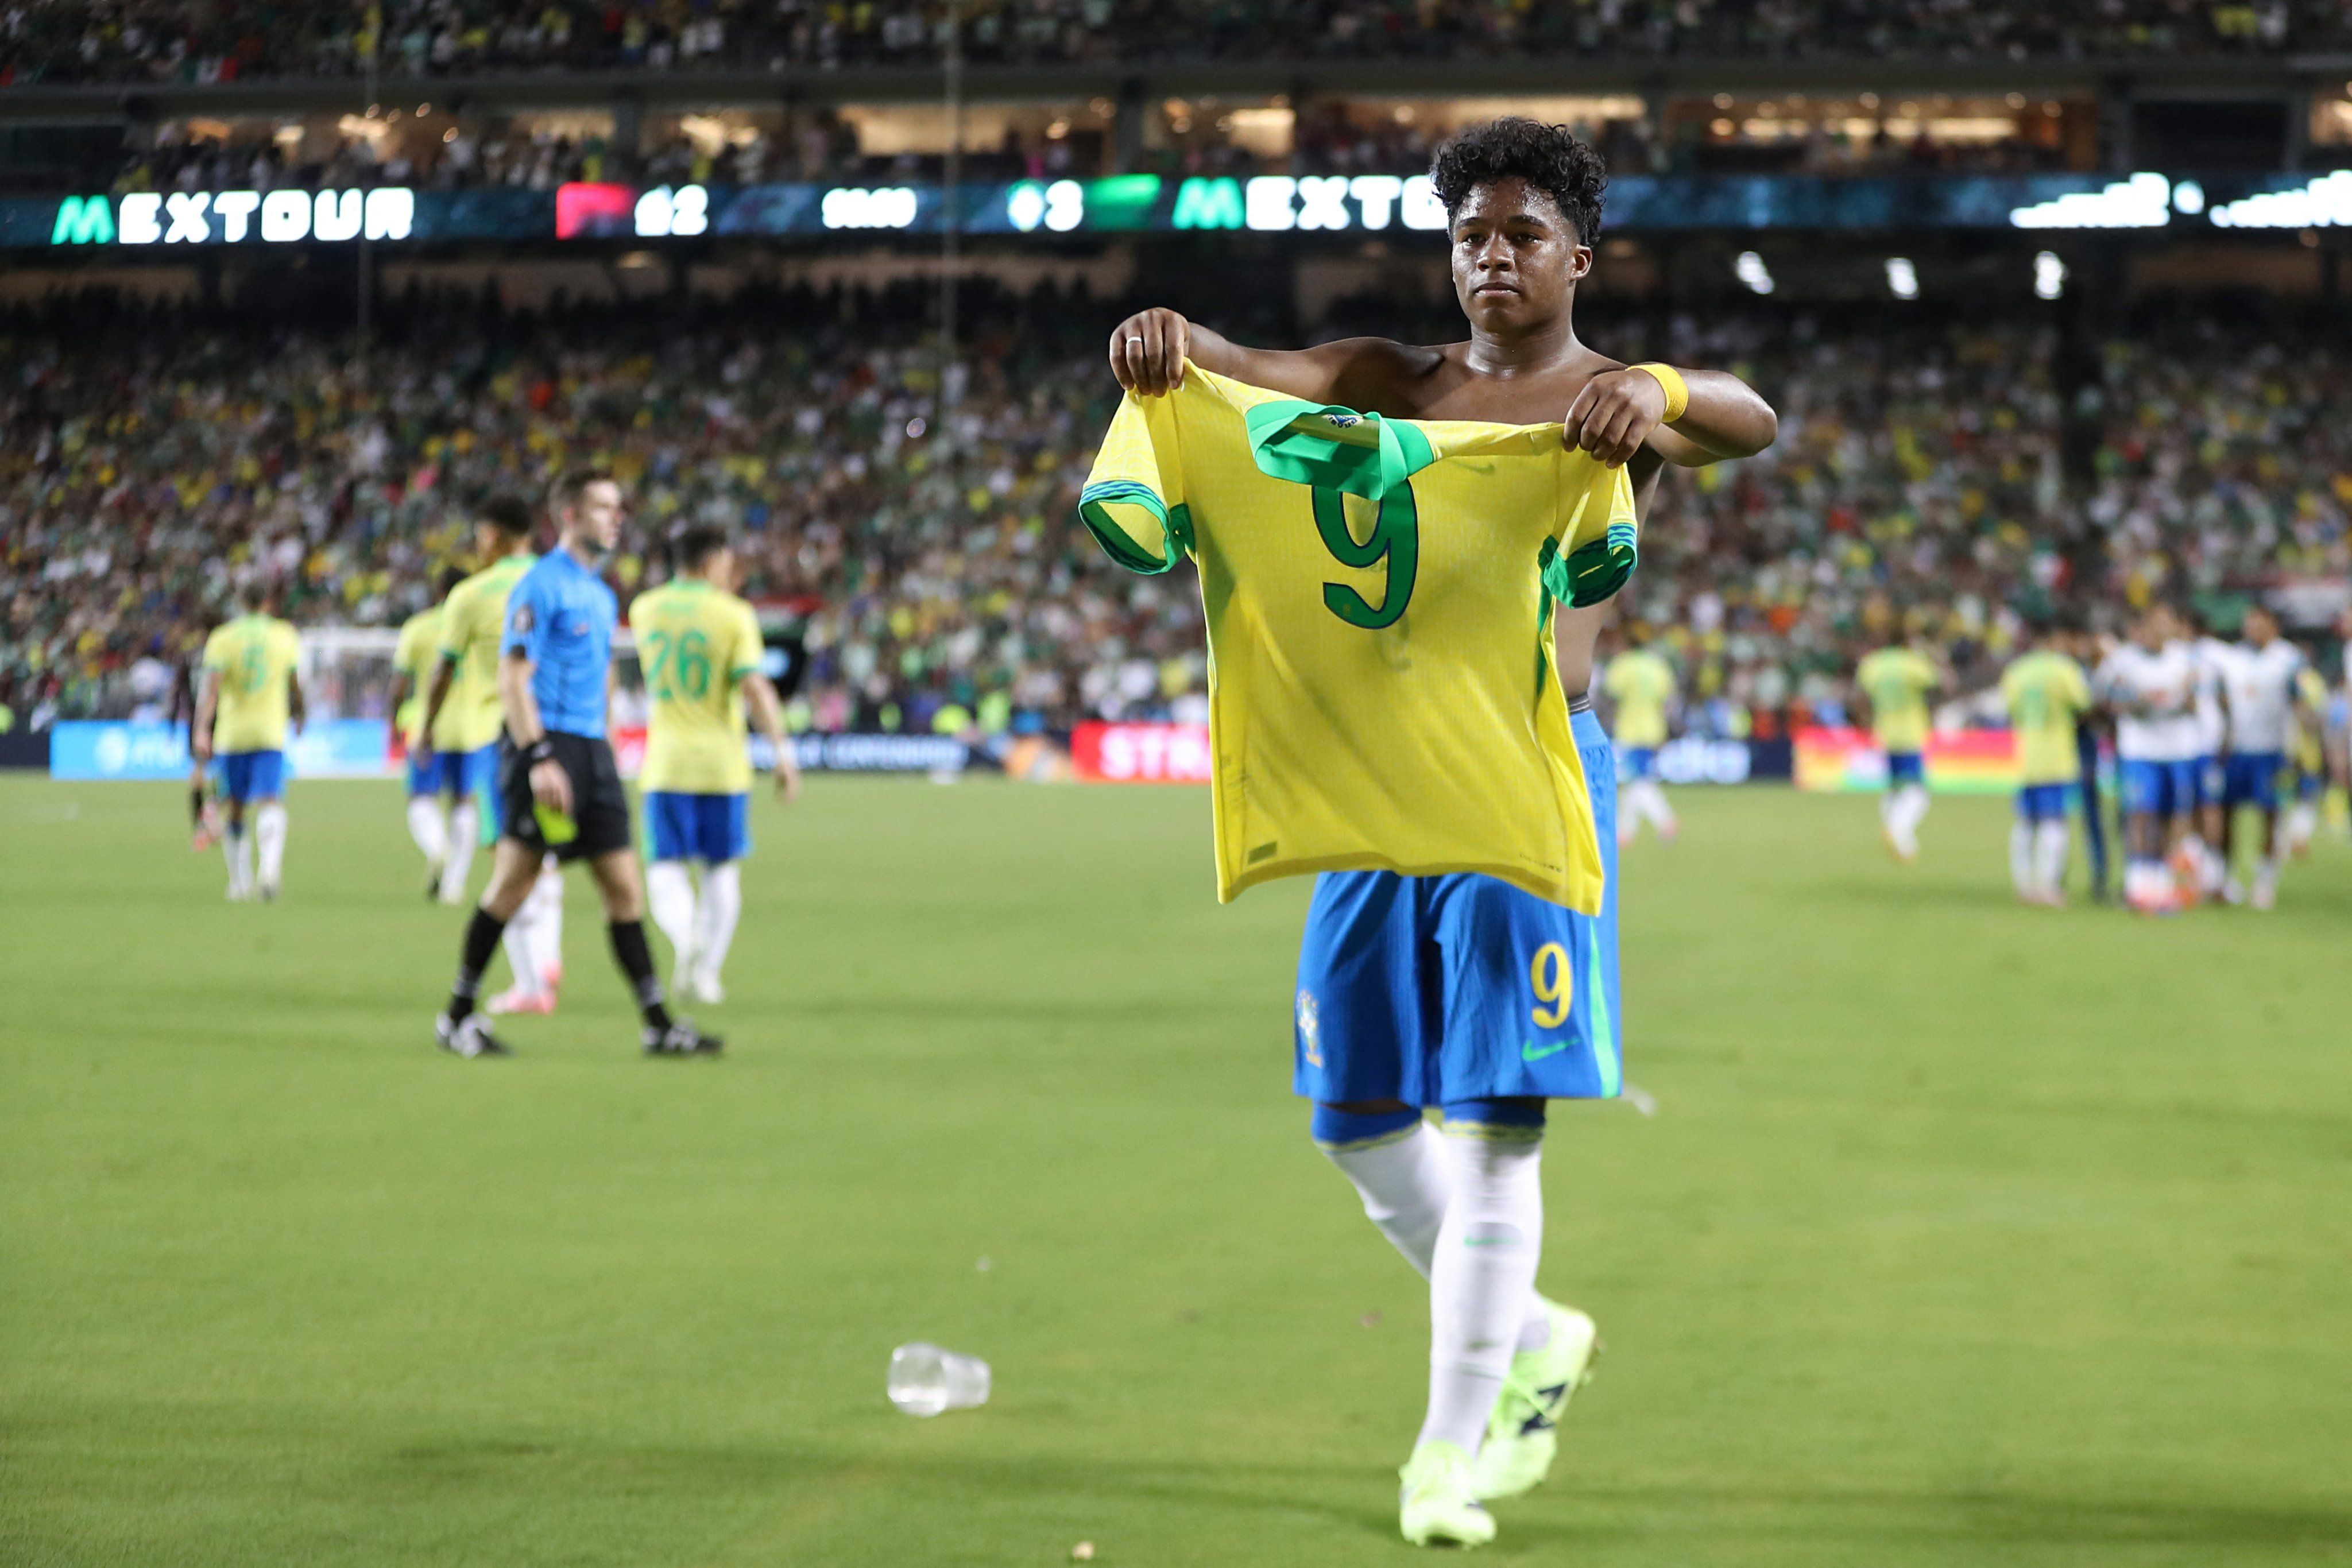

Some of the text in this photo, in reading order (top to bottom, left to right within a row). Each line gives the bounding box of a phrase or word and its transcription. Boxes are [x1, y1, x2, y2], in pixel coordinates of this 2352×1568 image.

[51, 187, 414, 245] MEXTOUR
[1312, 478, 1419, 630] 9
[647, 630, 710, 700] 26
[1530, 942, 1573, 1029] 9
